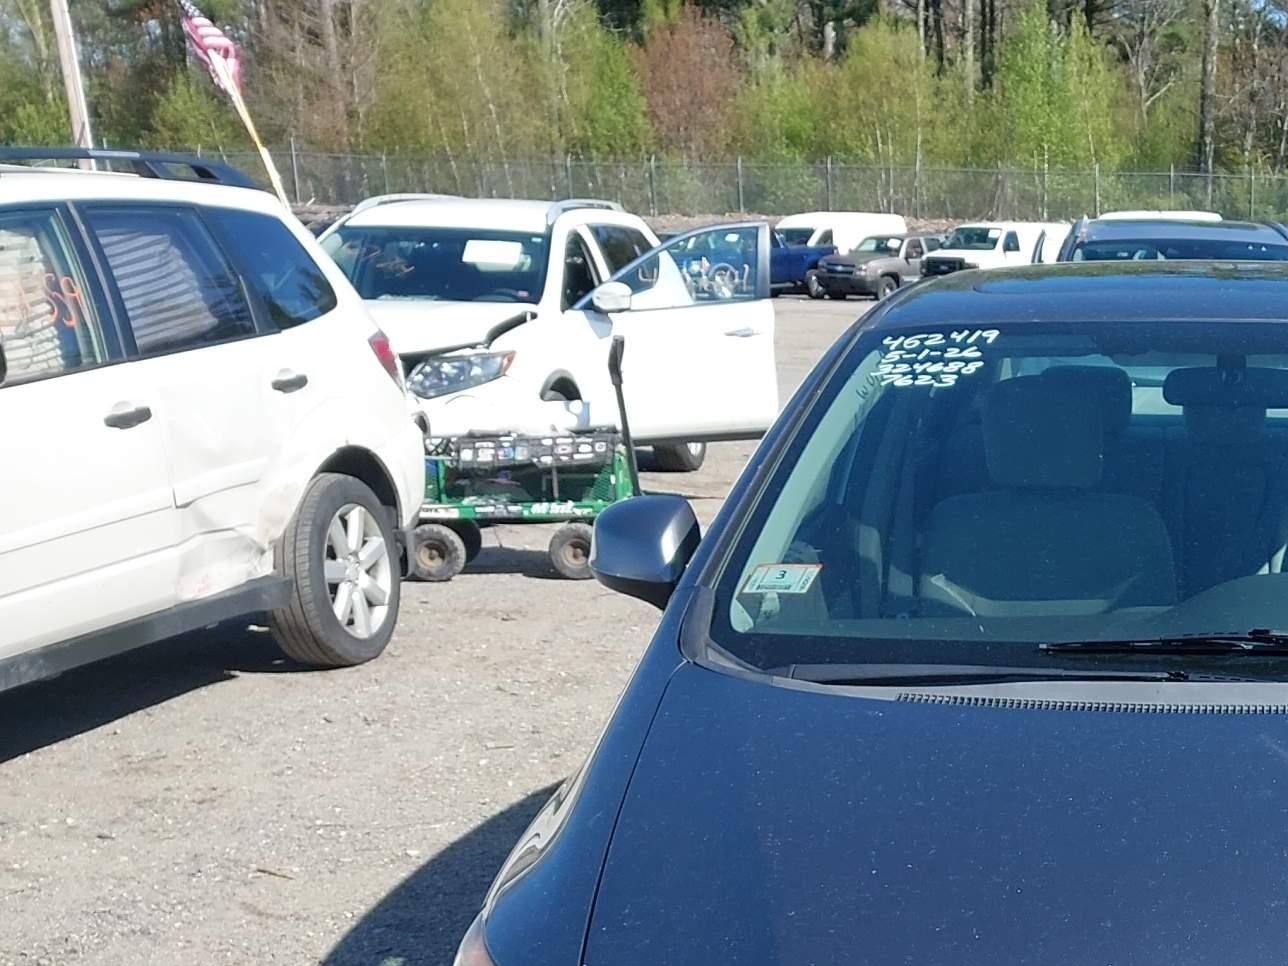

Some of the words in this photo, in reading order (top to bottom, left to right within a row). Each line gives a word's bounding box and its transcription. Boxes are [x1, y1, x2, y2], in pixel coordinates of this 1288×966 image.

[881, 346, 982, 363] 5-1-26
[880, 374, 959, 387] 7623
[775, 569, 787, 579] 3
